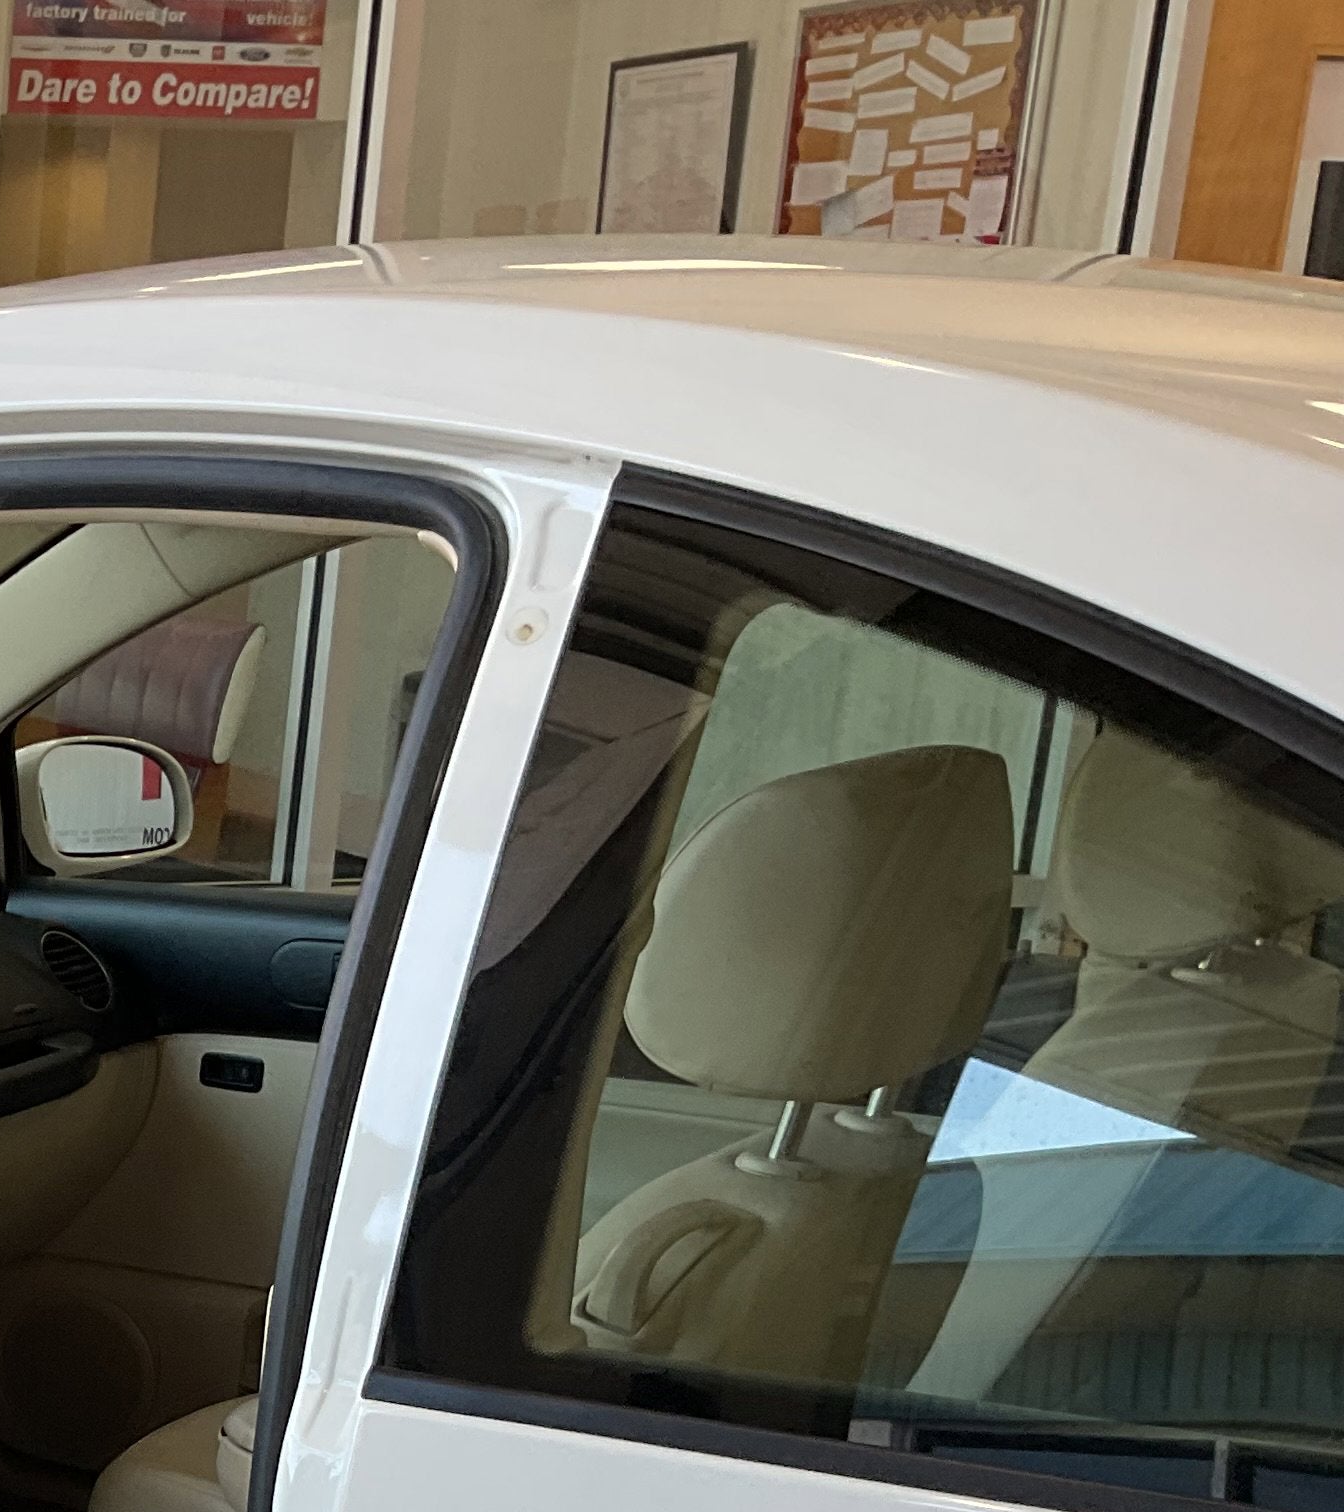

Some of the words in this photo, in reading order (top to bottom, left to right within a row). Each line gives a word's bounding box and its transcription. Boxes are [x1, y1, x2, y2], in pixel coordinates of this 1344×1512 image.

[27, 4, 88, 22] factory
[94, 6, 161, 22] trained
[162, 8, 186, 25] for
[17, 69, 97, 103] Dare
[108, 73, 142, 105] to
[152, 73, 315, 115] Compare!
